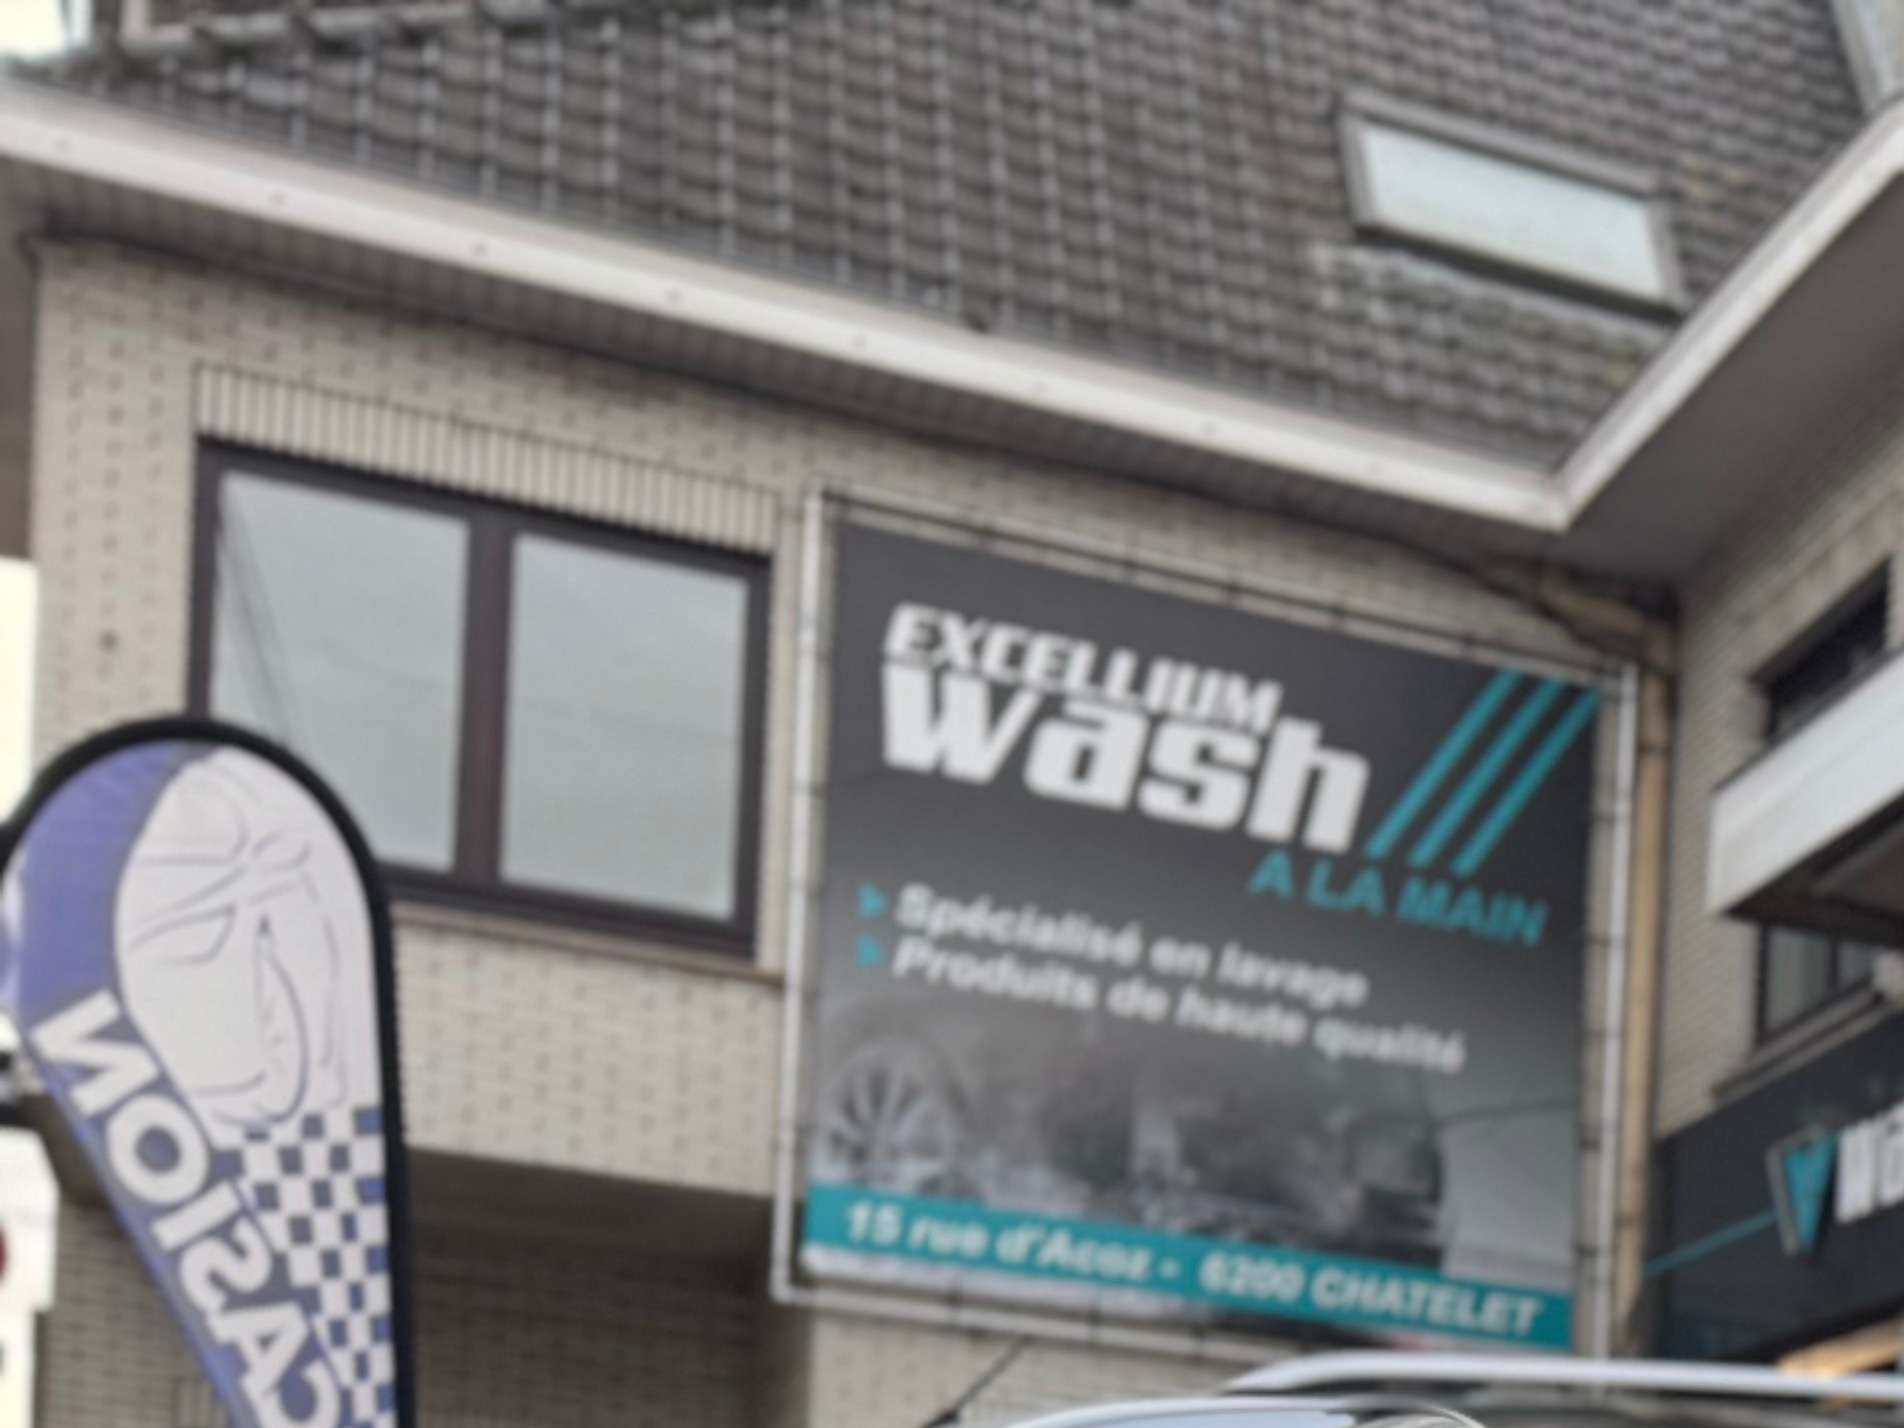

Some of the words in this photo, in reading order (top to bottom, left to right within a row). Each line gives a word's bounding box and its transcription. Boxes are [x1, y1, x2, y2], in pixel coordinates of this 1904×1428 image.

[885, 602, 1282, 732] EXCELLIUM
[894, 882, 1140, 965] Spécialisé
[1149, 931, 1212, 978] en
[1219, 940, 1371, 1013] lavage
[1308, 857, 1383, 918] LA
[1398, 873, 1552, 947] MAIN
[891, 937, 1097, 1013] Produits
[1107, 976, 1168, 1024] de
[1177, 989, 1307, 1048] haute
[1314, 1013, 1466, 1076] qualité
[844, 1200, 900, 1243] 15
[908, 1217, 986, 1261] rue
[996, 1224, 1153, 1283] d'Acoz
[1198, 1251, 1304, 1306] 6200
